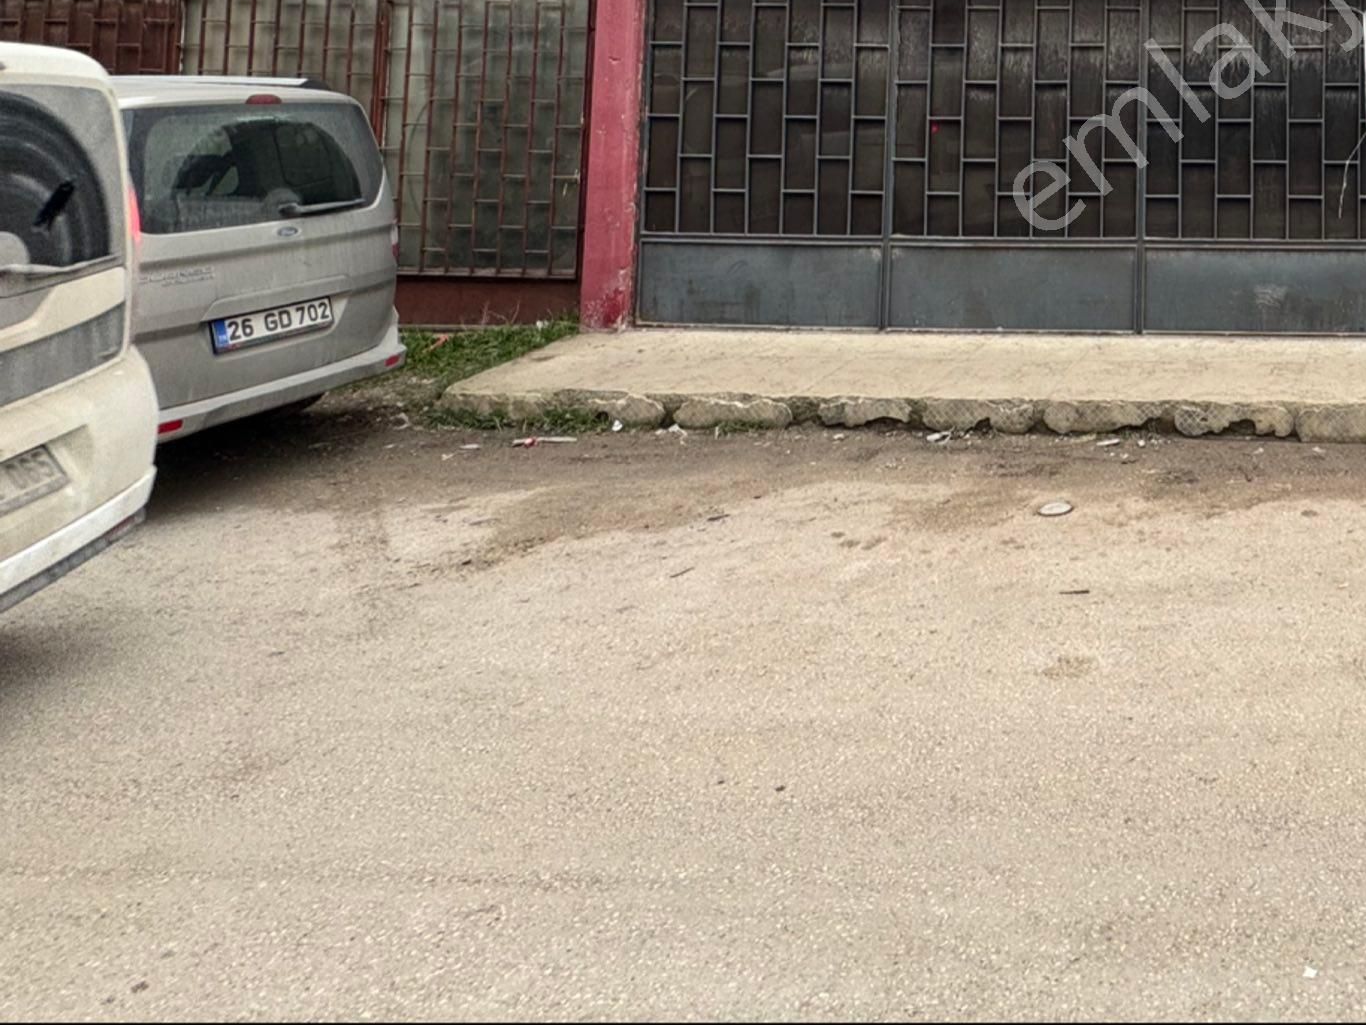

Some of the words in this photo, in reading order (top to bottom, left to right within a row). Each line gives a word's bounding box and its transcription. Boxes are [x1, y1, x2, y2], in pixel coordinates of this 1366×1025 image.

[228, 318, 254, 342] 26
[264, 310, 291, 332] GD
[296, 302, 330, 325] 702
